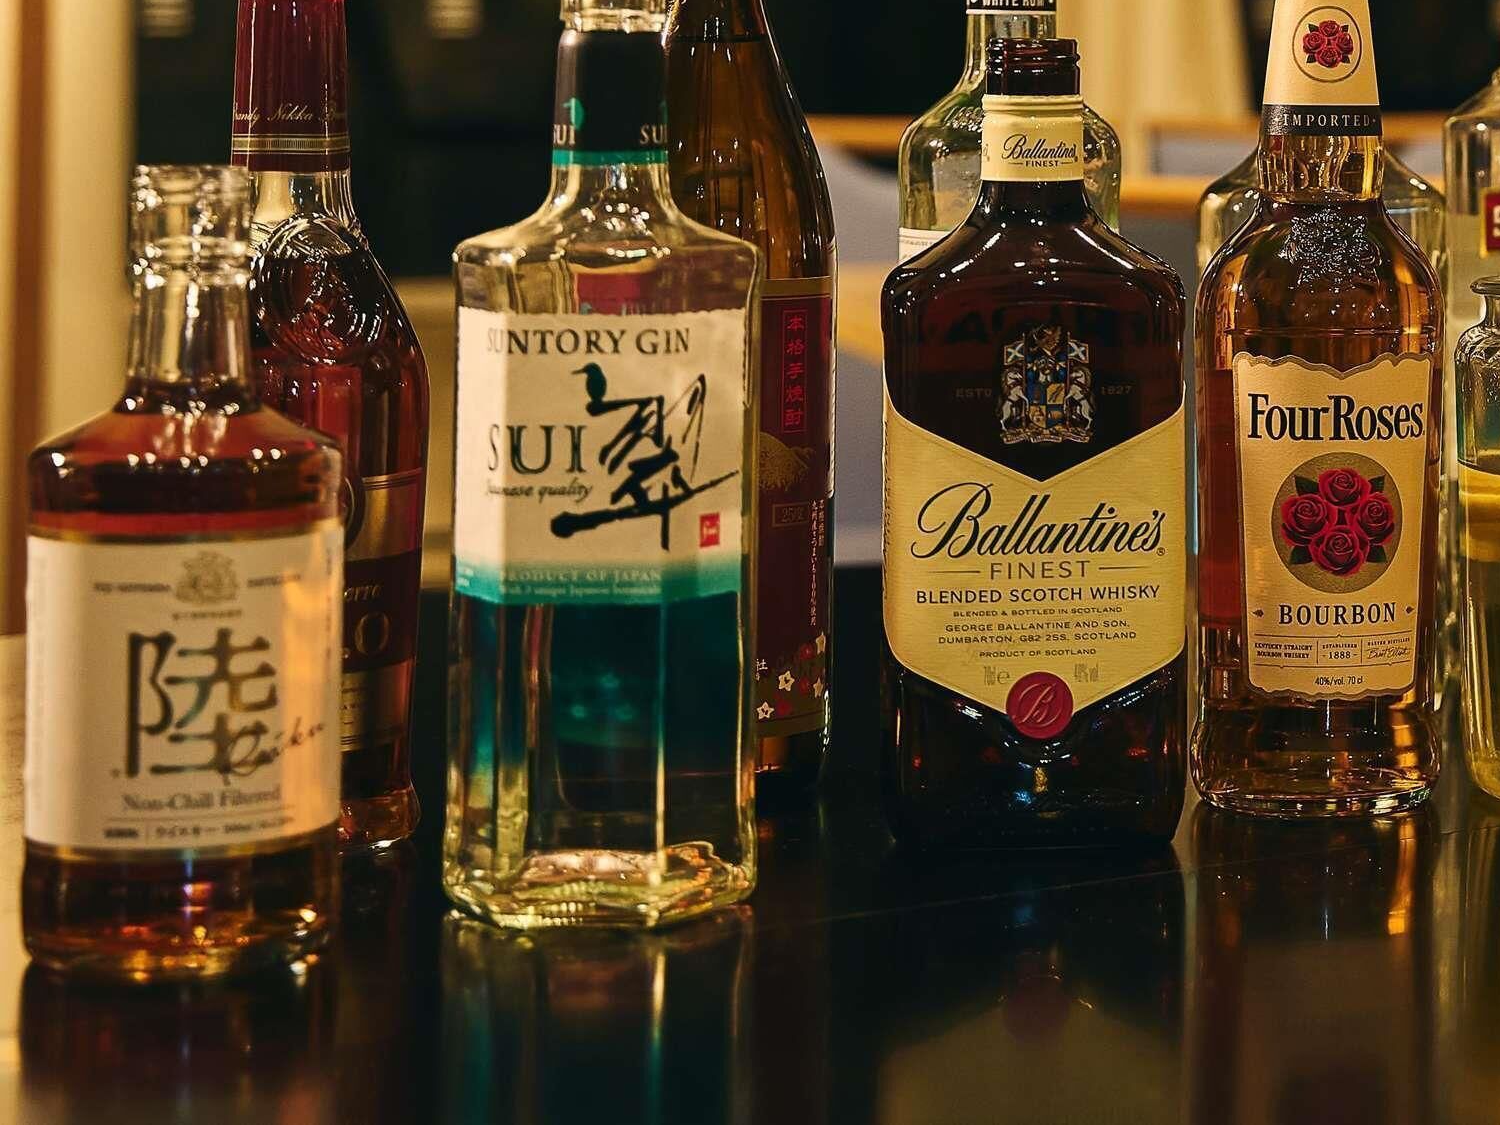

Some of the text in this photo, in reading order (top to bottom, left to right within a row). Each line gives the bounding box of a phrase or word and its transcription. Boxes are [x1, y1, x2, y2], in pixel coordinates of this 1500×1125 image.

[1282, 113, 1371, 128] IMPORTED
[640, 124, 668, 145] SUI
[1001, 133, 1077, 160] Ballantine's
[488, 328, 691, 355] SUNTORY GIN
[488, 424, 588, 475] SUI
[538, 476, 593, 504] quality
[911, 482, 1168, 560] Ballantine's
[990, 560, 1092, 580] FINEST
[916, 585, 1160, 604] BLENDED SCOTCH WHISKY
[1011, 608, 1055, 616] BOTTLED
[1279, 602, 1396, 625] BOURBON
[945, 624, 993, 632] GEORGE
[997, 622, 1070, 631] BALLANTINE
[1019, 634, 1041, 642] G82
[1074, 631, 1136, 640] SCOTLAND
[1328, 651, 1351, 660] 1888
[127, 627, 278, 783] 陸
